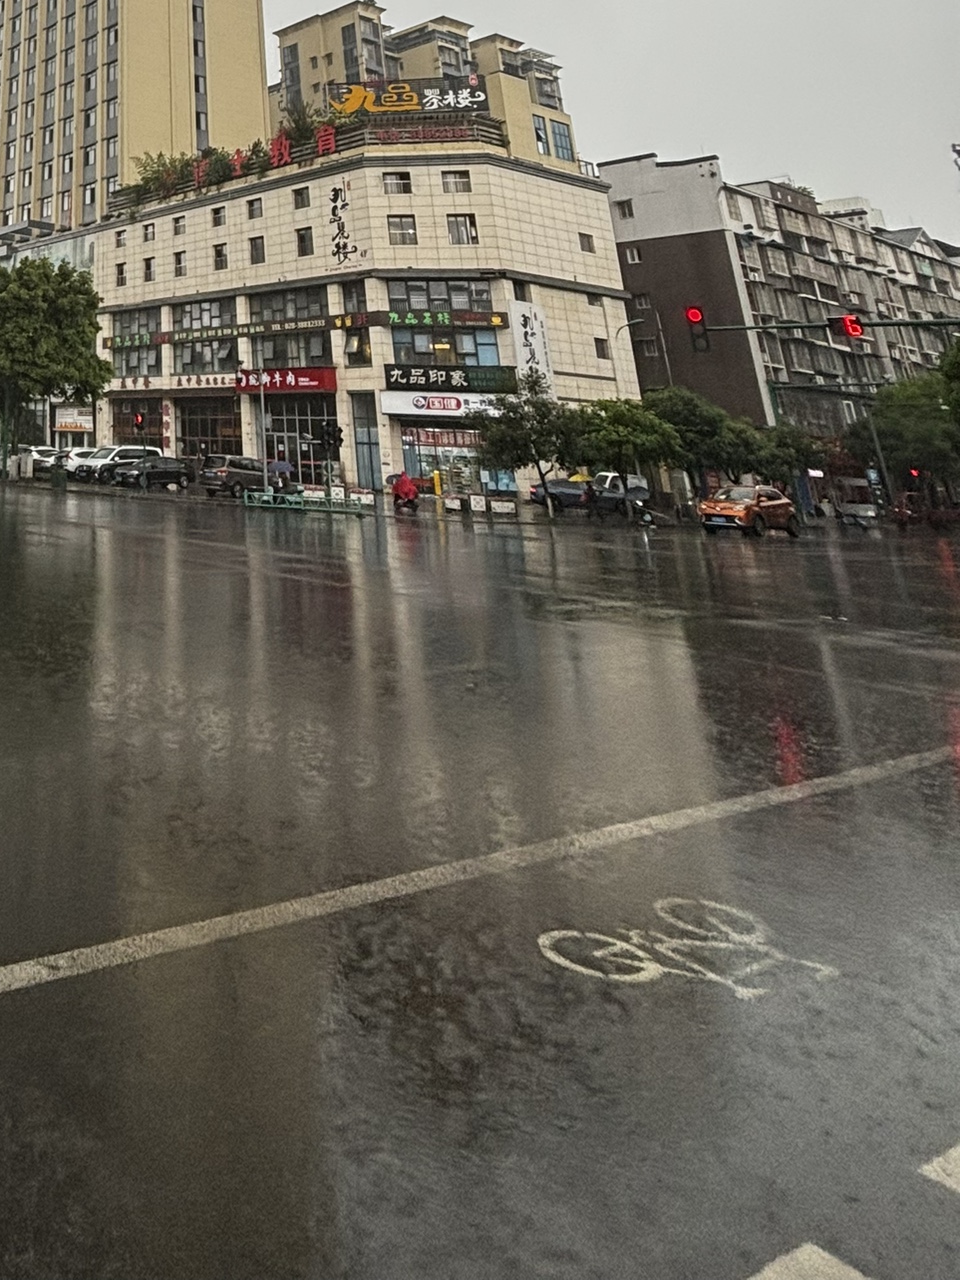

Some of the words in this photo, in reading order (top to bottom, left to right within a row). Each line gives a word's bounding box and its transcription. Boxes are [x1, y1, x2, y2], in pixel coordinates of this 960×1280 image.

[844, 315, 862, 336] 6
[390, 368, 469, 387] 九品印象
[429, 396, 458, 410] 国健
